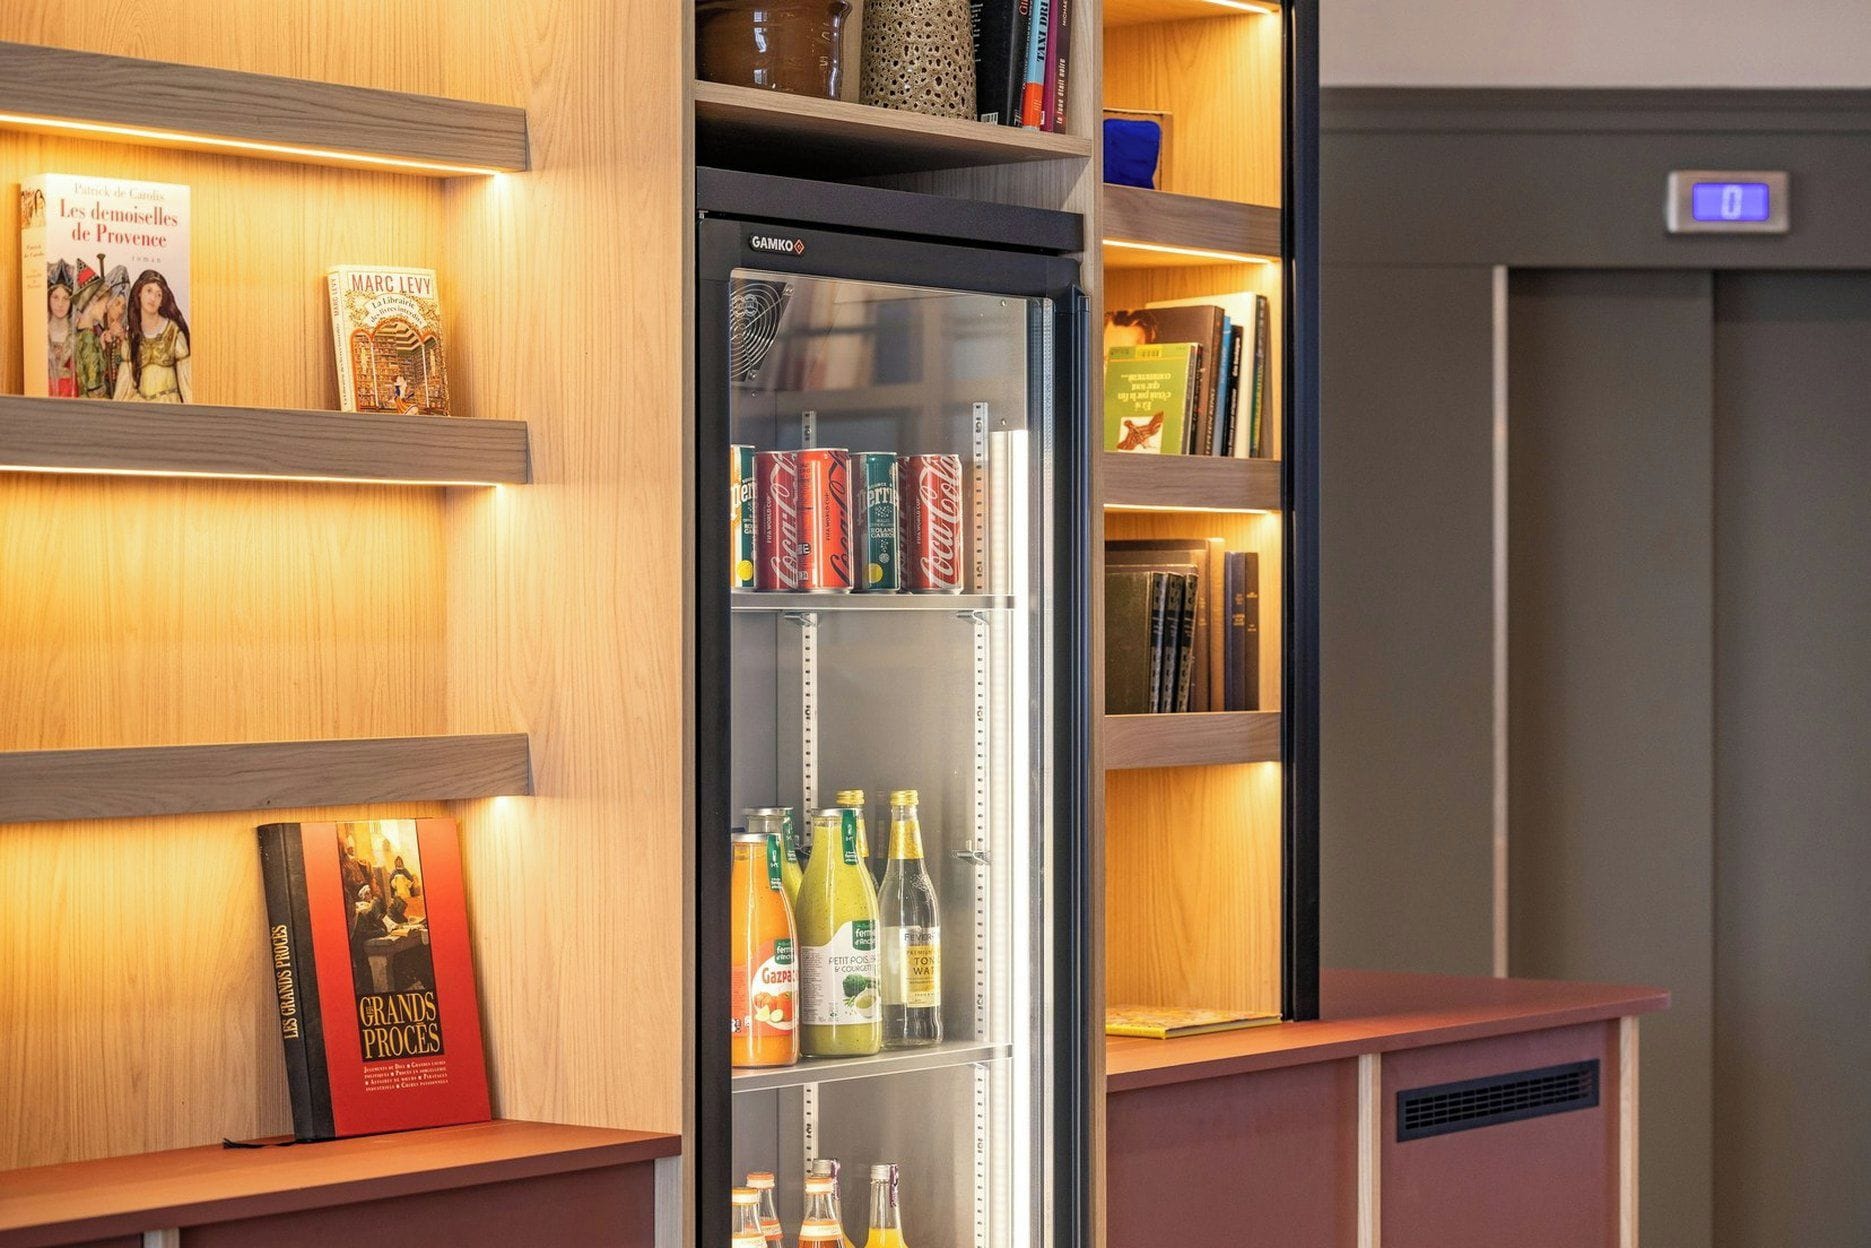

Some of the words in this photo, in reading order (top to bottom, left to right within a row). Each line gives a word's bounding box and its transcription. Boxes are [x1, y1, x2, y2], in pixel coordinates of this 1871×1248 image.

[1036, 31, 1047, 62] TAXI
[74, 183, 110, 197] Patrick
[1721, 184, 1743, 220] 0
[60, 198, 86, 218] Les
[91, 201, 178, 227] demoiselles
[72, 222, 90, 241] de
[96, 223, 168, 248] Provence
[752, 235, 793, 252] GAMKO
[352, 274, 394, 292] MARC
[399, 276, 431, 295] LEVY
[271, 924, 291, 968] PROCÈS
[828, 955, 849, 965] PETIT
[851, 955, 869, 964] POIS
[276, 970, 297, 1016] GRANDS
[360, 991, 437, 1027] GRANDS
[282, 1018, 299, 1040] LES
[363, 1022, 441, 1059] PROCÈS
